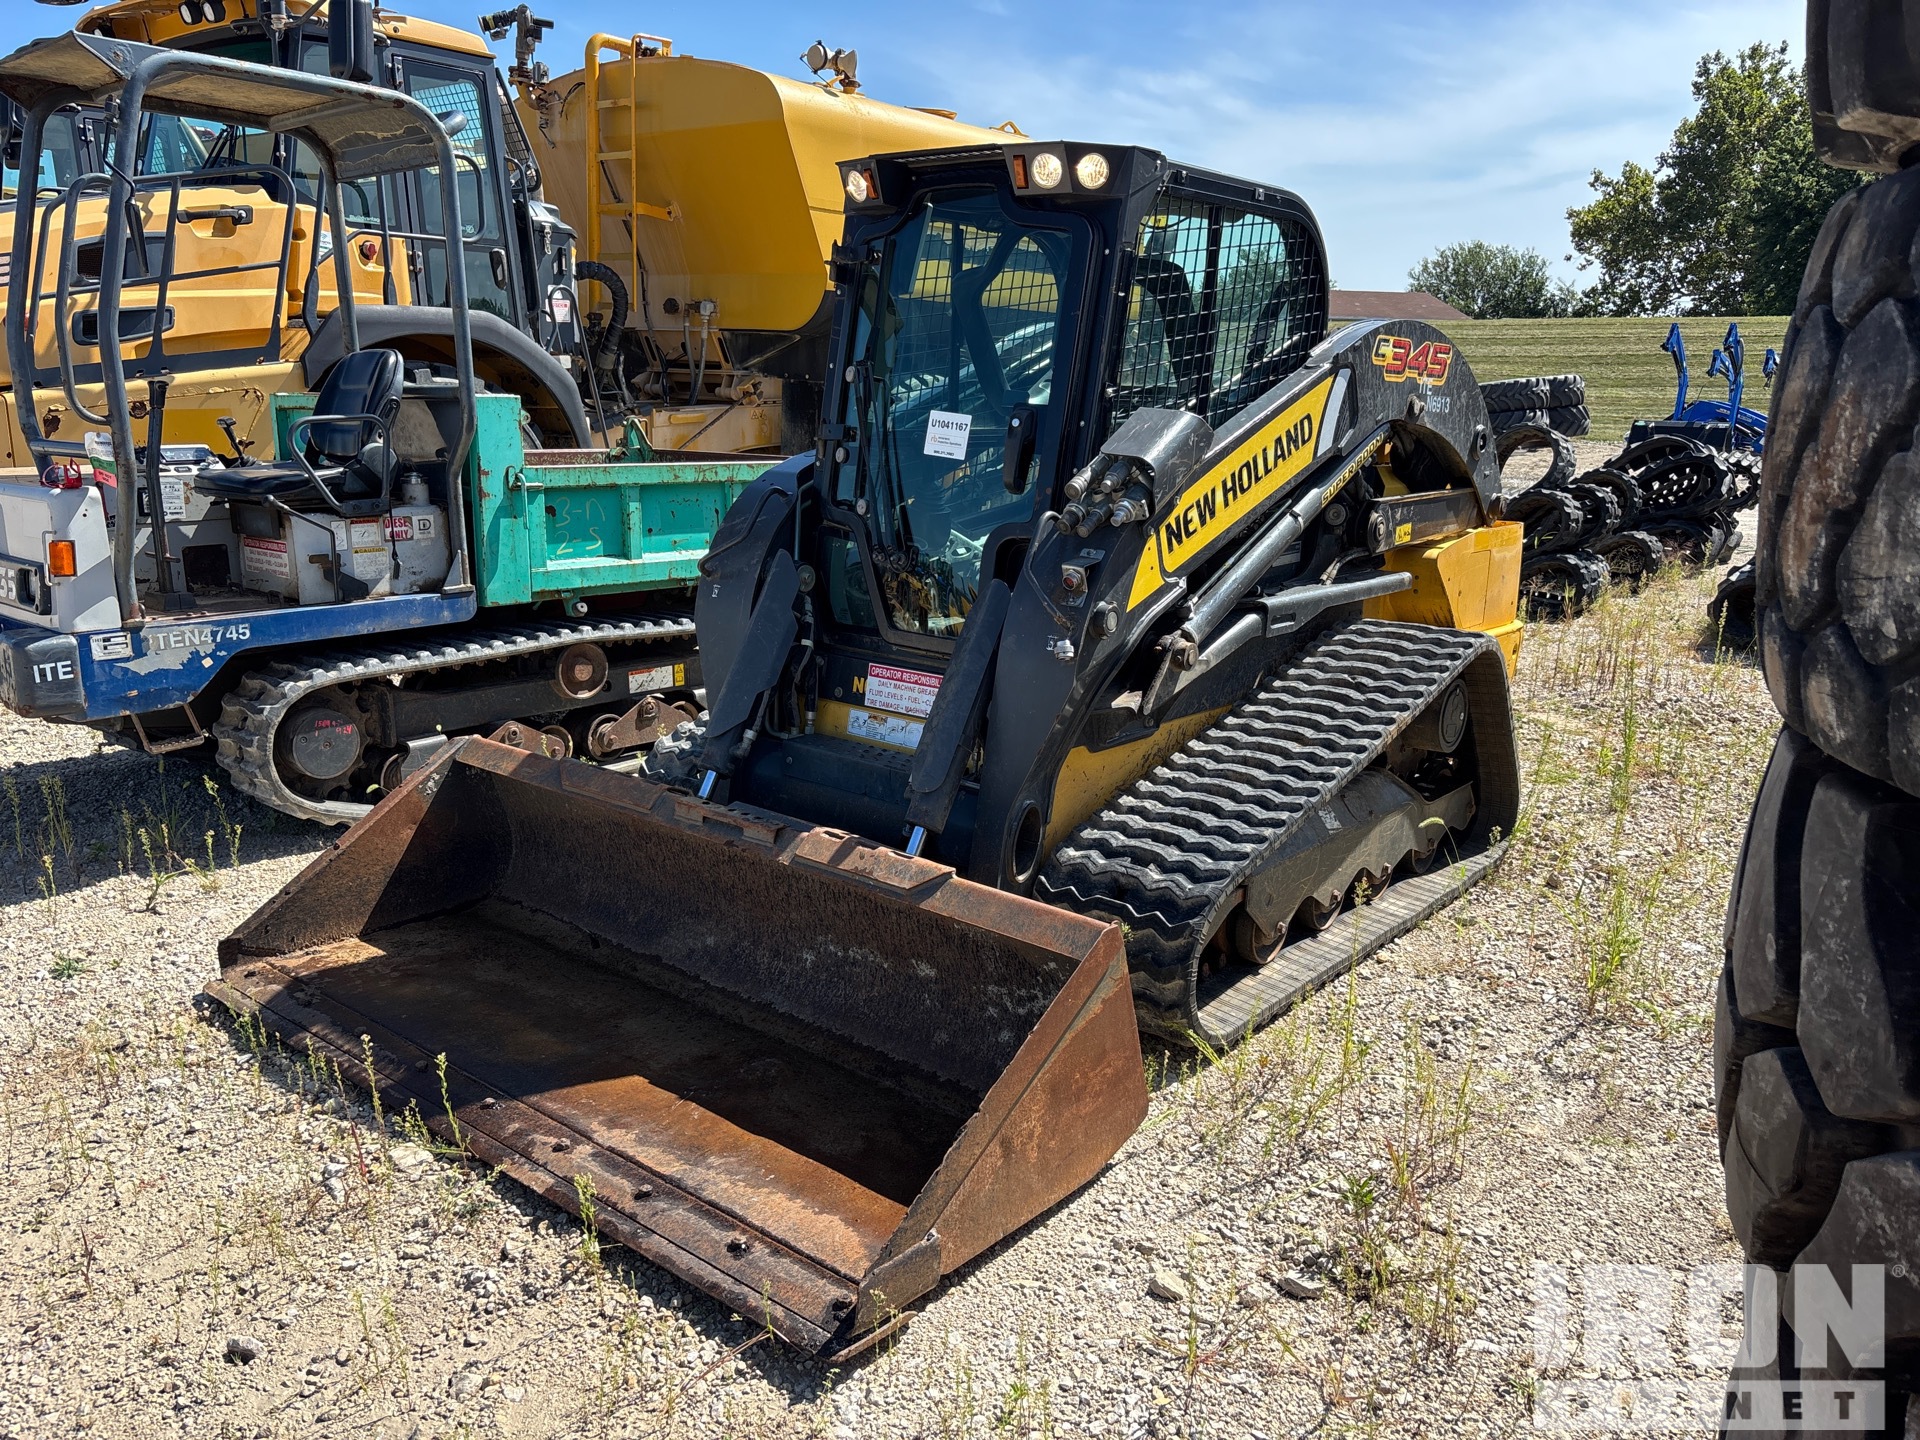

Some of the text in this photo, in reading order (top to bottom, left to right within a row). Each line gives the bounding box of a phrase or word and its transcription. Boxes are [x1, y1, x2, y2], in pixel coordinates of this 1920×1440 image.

[1373, 336, 1452, 382] C345
[1426, 396, 1450, 413] N6913
[931, 418, 968, 431] U1041167
[1321, 431, 1384, 508] SUPER BOOM
[1165, 413, 1313, 554] NEW HOLLAND
[384, 517, 409, 529] DESE
[33, 660, 74, 683] ITE
[871, 667, 902, 680] OPERATOR
[853, 676, 868, 693] N
[877, 680, 892, 688] DAILY
[893, 682, 916, 693] MACHINE
[866, 698, 878, 706] TIRE
[878, 700, 900, 711] DAMAGE
[869, 688, 884, 697] FLUID
[884, 691, 903, 700] LEVELS
[907, 696, 920, 705] FUEL
